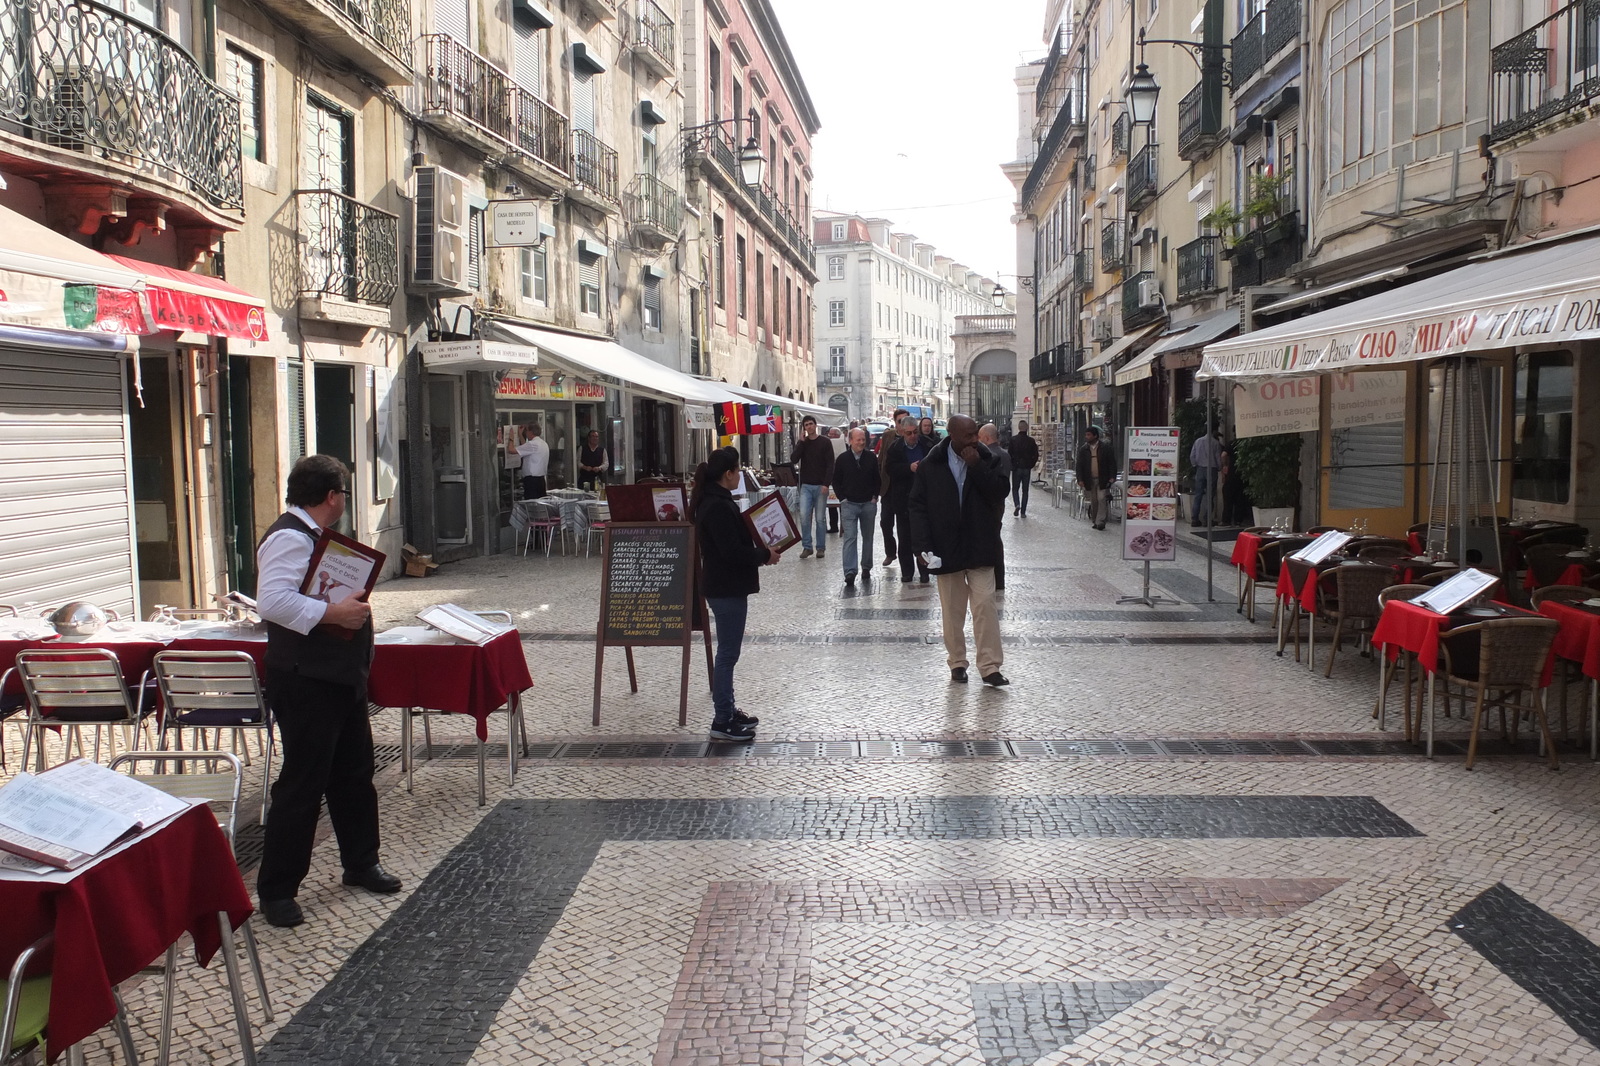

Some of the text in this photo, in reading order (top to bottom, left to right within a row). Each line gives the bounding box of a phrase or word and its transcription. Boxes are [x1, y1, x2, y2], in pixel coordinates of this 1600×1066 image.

[158, 307, 204, 326] Kebab
[1359, 330, 1396, 360] CIAO
[1414, 315, 1478, 354] MILANO
[575, 382, 605, 398] CERVEJARIA
[320, 560, 338, 572] Come
[344, 571, 359, 581] bebe
[326, 554, 360, 574] restaurante
